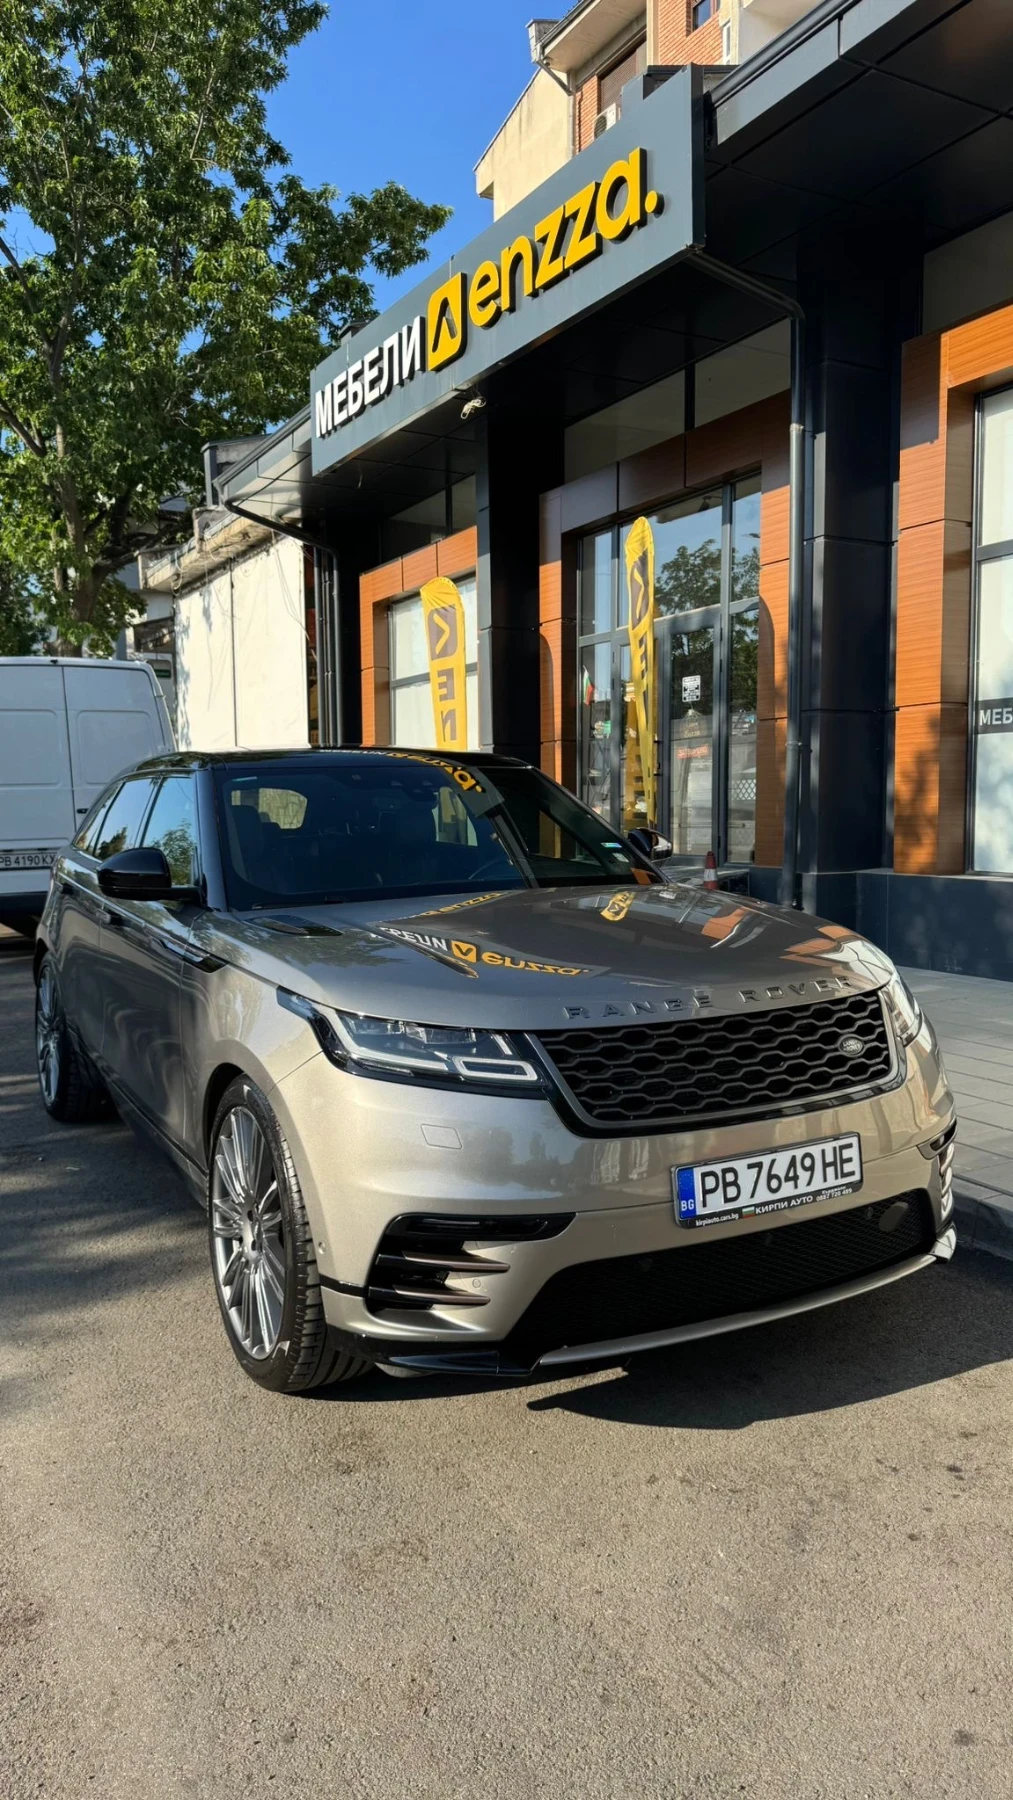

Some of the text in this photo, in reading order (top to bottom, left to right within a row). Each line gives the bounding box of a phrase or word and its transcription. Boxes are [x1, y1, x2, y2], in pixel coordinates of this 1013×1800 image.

[315, 147, 658, 438] МЕБЕЛИ enzza.
[980, 707, 1013, 726] МЕБ
[14, 855, 40, 866] 4190
[563, 975, 851, 1020] RANGE ROVER
[701, 1142, 856, 1208] PB 7649 HE
[681, 1199, 695, 1212] BG
[755, 1195, 814, 1215] КИРПИ АУТО
